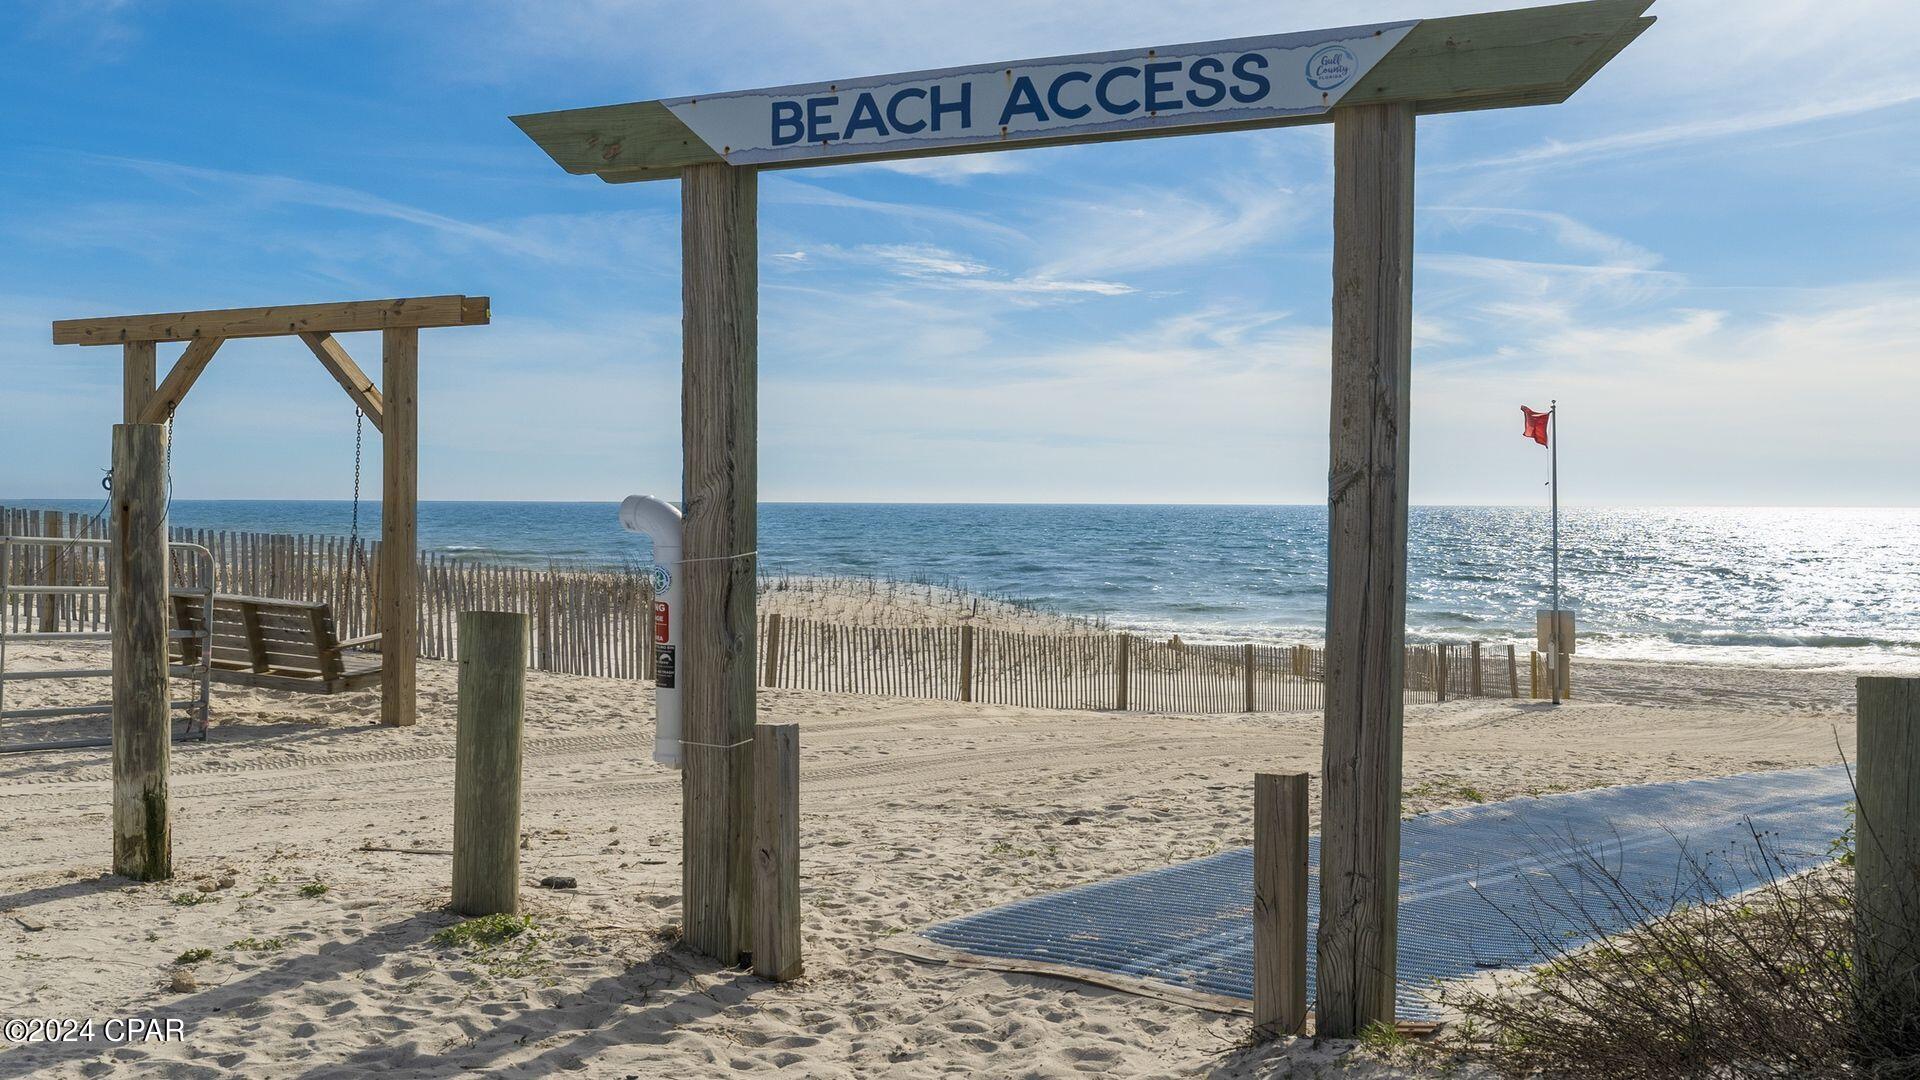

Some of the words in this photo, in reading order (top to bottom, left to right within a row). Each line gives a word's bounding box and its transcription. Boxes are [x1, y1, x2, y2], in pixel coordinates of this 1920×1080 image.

[1321, 53, 1342, 66] Gulf
[1316, 64, 1348, 77] County
[772, 82, 972, 147] BEACH
[999, 53, 1271, 125] ACCESS
